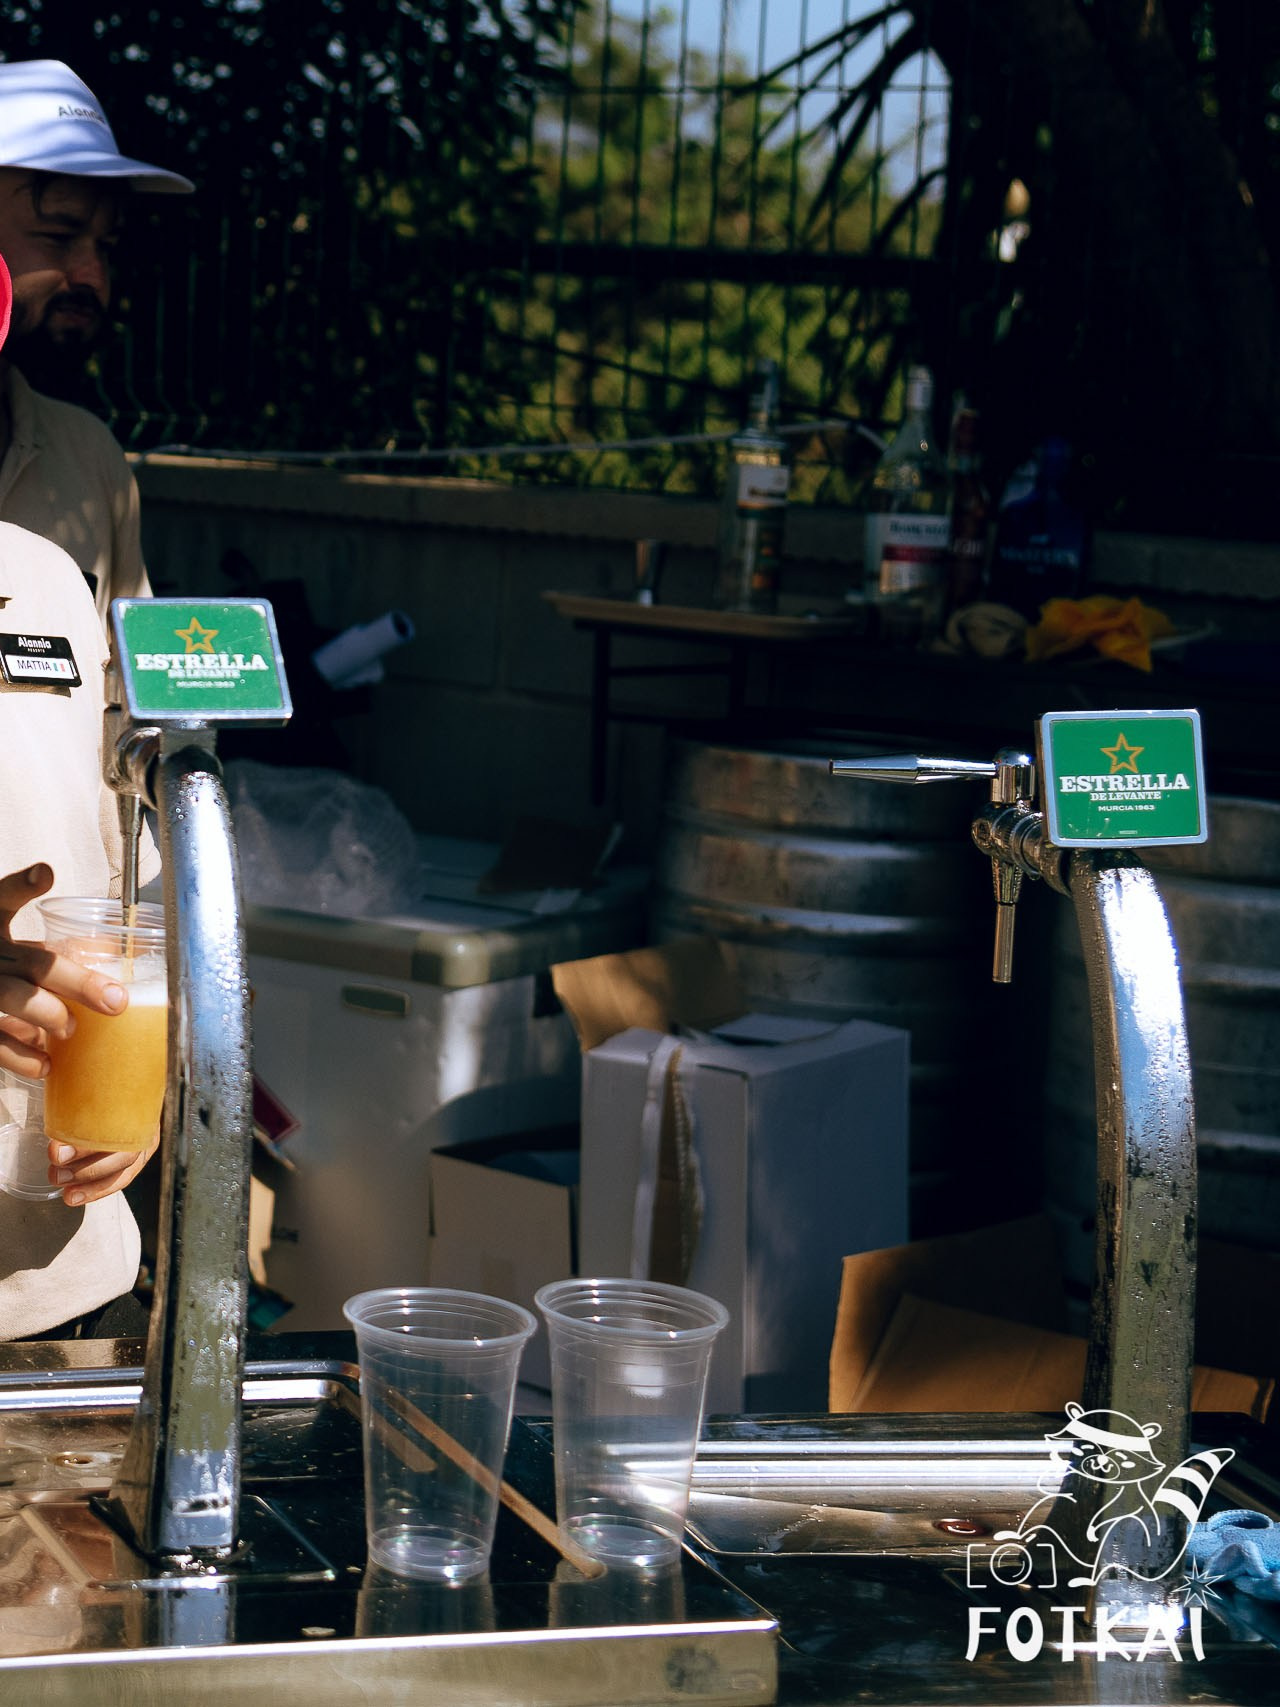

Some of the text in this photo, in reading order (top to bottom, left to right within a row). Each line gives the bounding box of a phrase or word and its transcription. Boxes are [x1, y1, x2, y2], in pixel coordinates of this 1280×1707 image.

[17, 636, 52, 649] Alannia
[17, 659, 52, 671] MATTIA
[134, 653, 269, 671] ESTRELLA
[1059, 773, 1190, 792] ESTRELLA
[1090, 791, 1162, 801] DE LEVANTE
